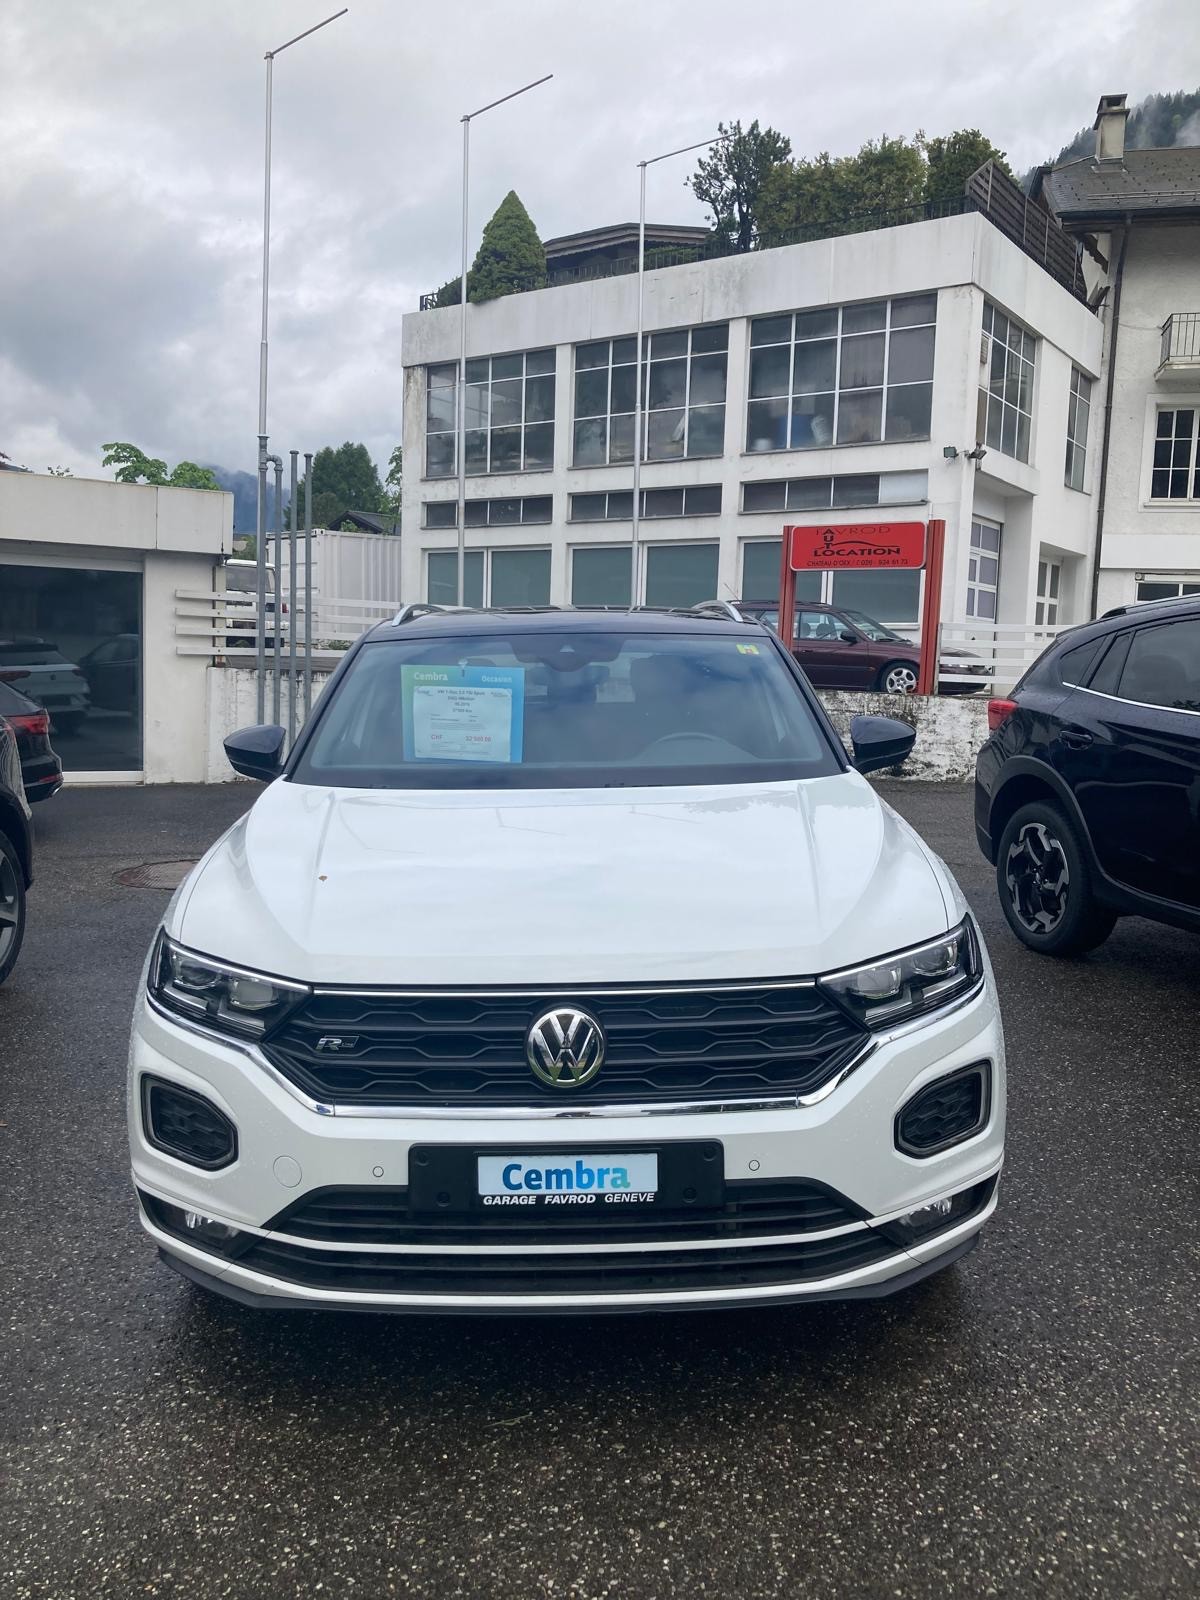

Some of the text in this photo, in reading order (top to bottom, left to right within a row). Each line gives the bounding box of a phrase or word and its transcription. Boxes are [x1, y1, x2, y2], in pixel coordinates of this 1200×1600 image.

[813, 547, 901, 557] LOCATION
[413, 671, 513, 683] Cembra Occasion
[502, 1160, 631, 1191] Cembra
[483, 1192, 656, 1206] GARAGE FAVROD GENEVE
